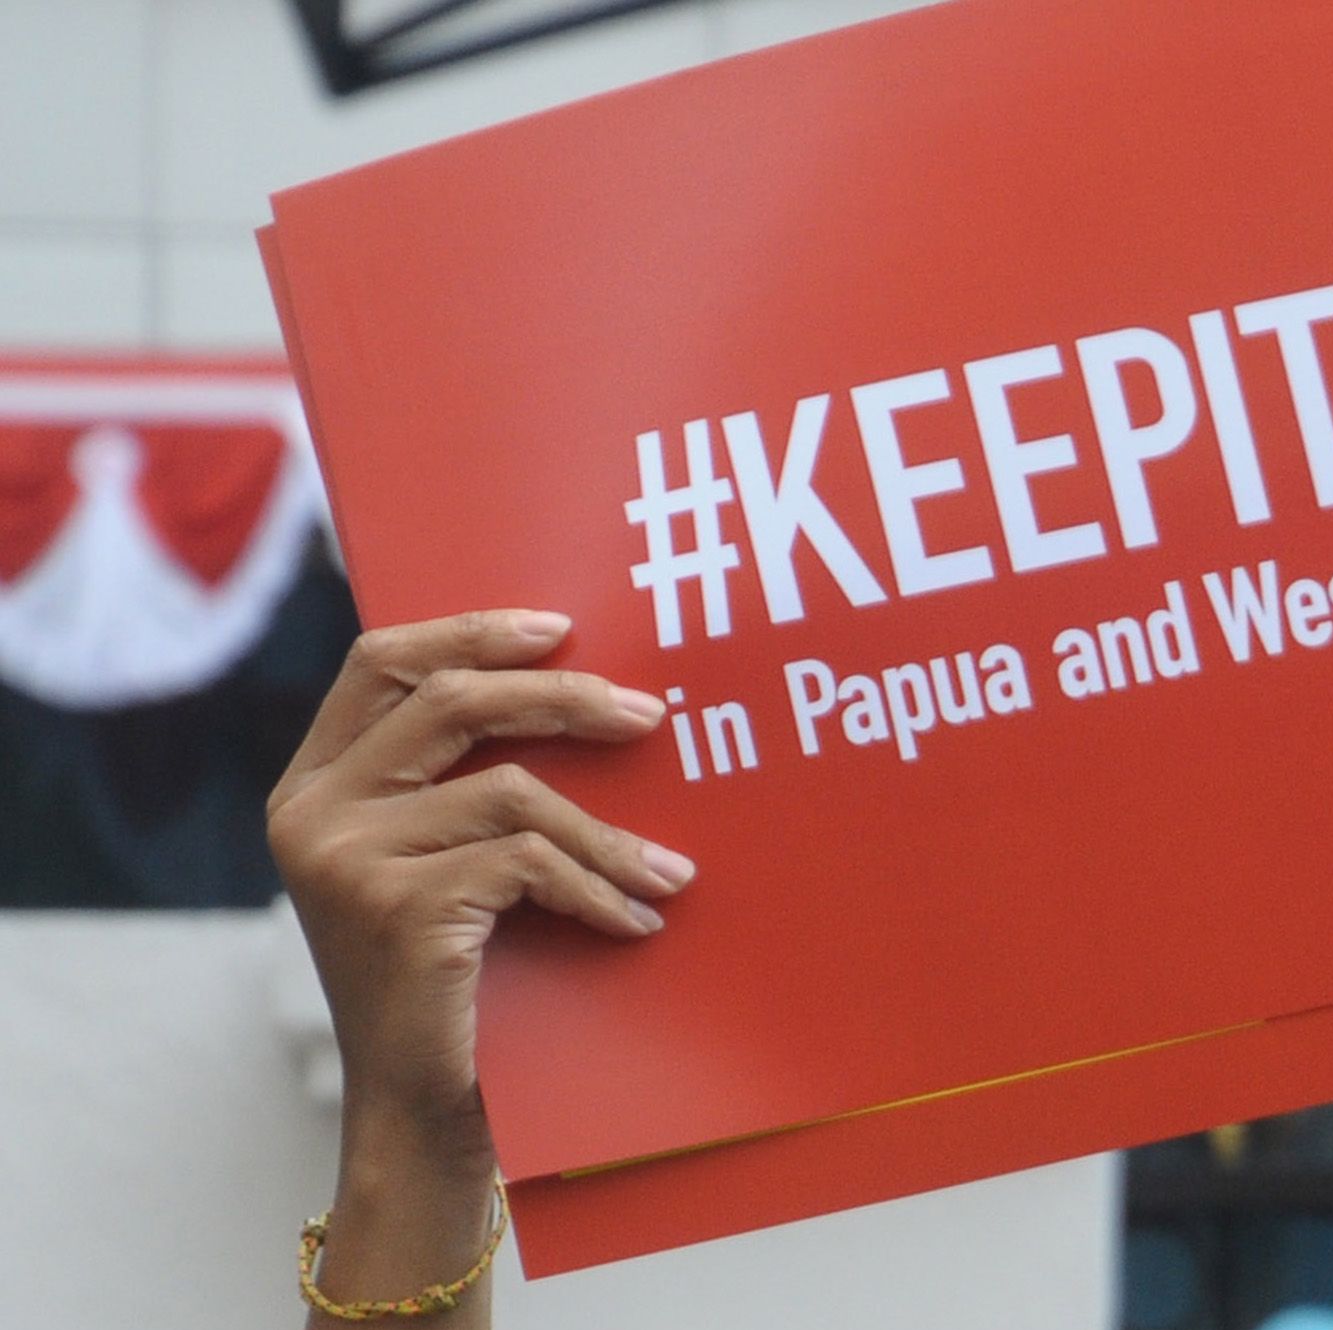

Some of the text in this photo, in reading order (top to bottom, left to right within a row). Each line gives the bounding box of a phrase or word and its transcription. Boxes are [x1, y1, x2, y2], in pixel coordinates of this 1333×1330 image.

[666, 686, 759, 781] in
[784, 644, 1033, 761] Papua
[1052, 580, 1201, 699] and
